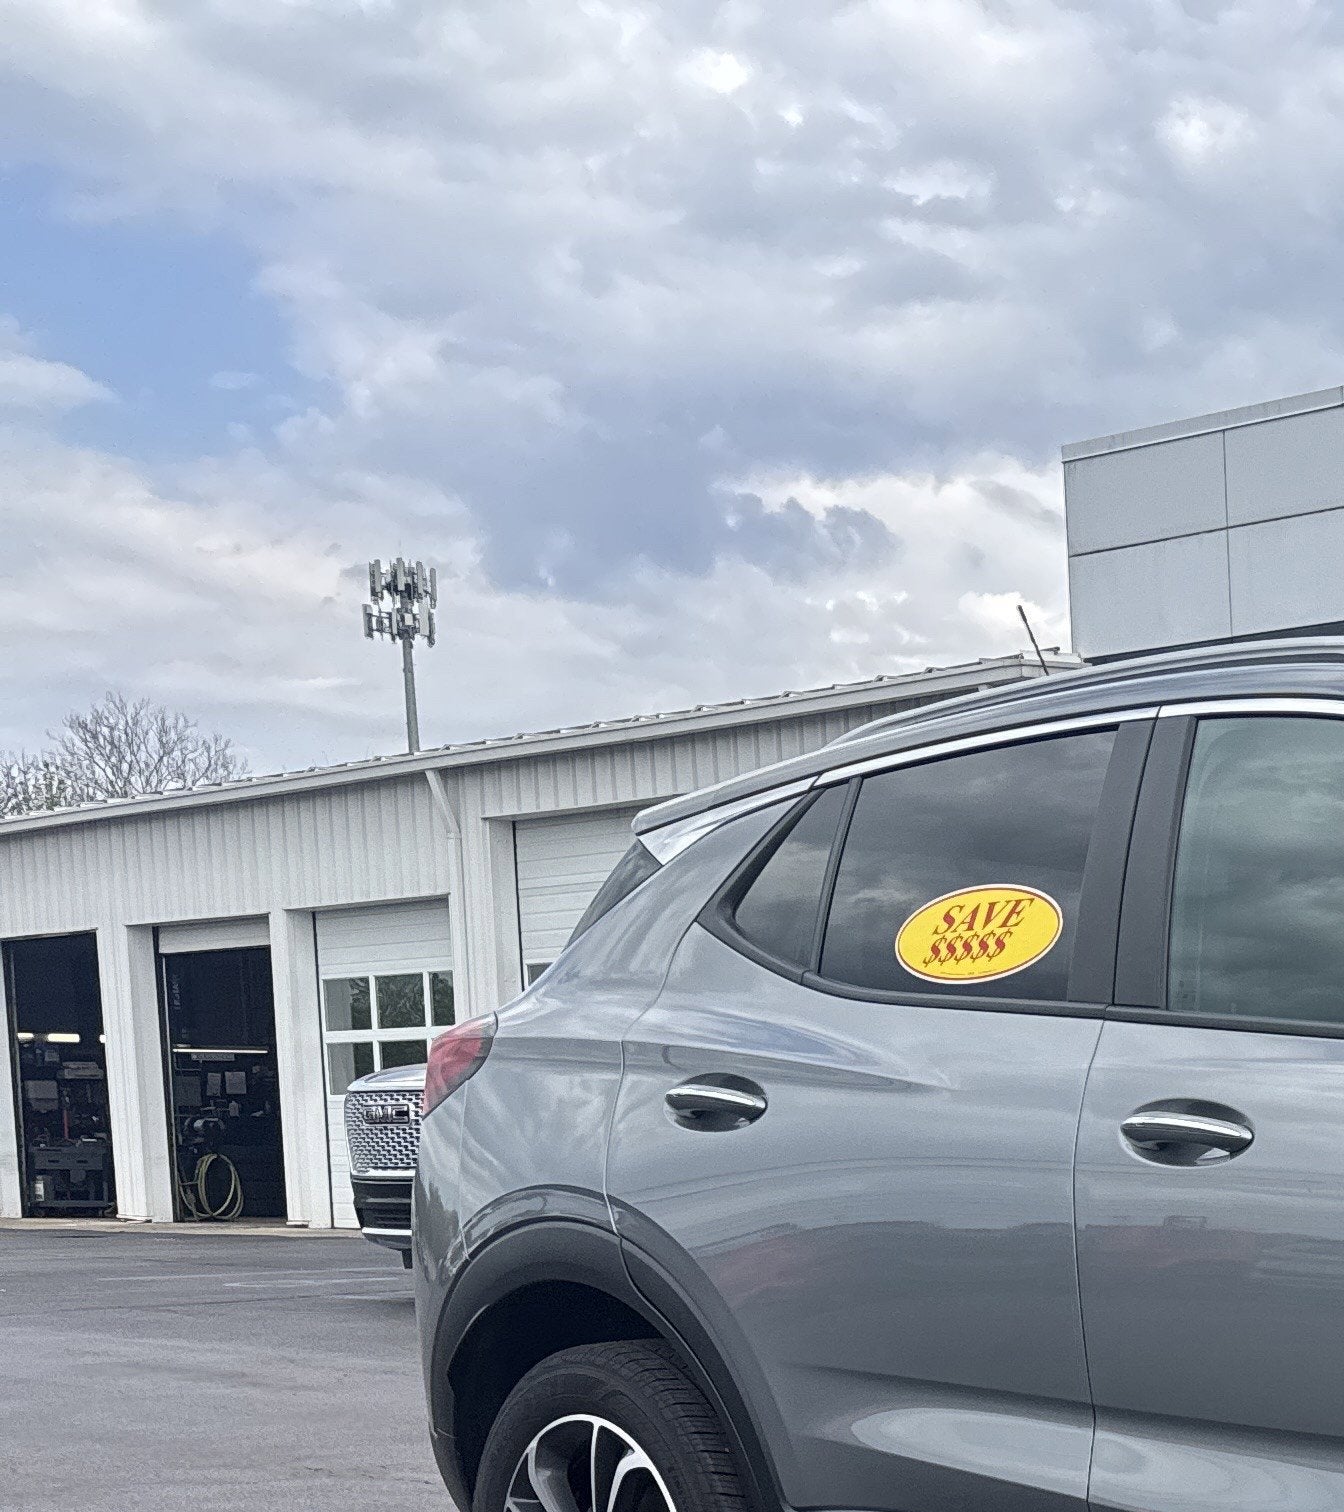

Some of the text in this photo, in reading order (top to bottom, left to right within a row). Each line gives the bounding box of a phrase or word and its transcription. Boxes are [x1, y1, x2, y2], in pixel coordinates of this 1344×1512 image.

[933, 898, 1035, 935] SAVE
[923, 929, 1013, 967] $$$$$
[363, 1105, 408, 1123] GMC
